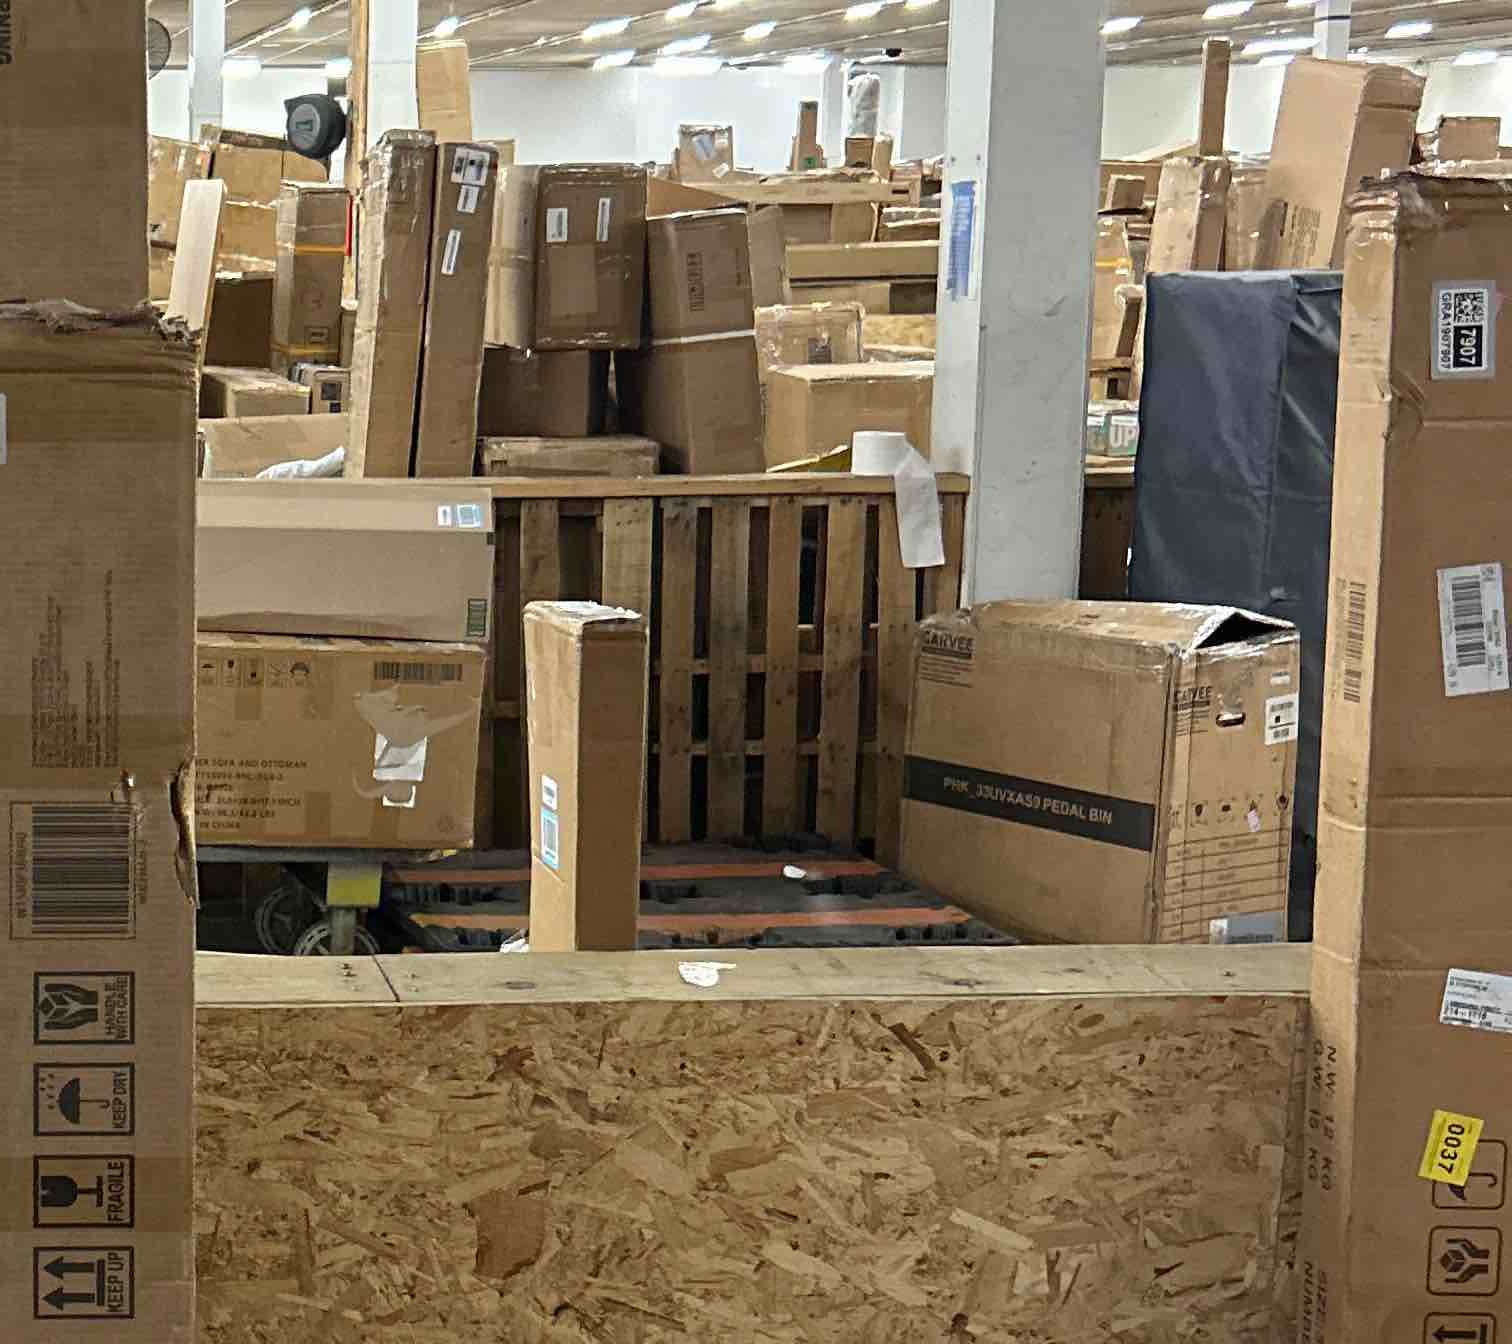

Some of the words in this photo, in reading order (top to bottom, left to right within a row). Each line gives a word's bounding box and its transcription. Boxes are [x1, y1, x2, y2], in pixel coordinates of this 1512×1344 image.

[1459, 327, 1477, 365] 7907
[1042, 798, 1087, 820] PEDAL
[1088, 808, 1113, 825] BIN
[116, 975, 128, 1007] CARE
[106, 983, 116, 1036] HANDLE
[112, 1070, 127, 1095] DRY
[112, 1097, 127, 1129] KEEP
[1438, 1123, 1465, 1174] 0037
[106, 1160, 125, 1223] FRAGILE
[106, 1250, 125, 1272] UP
[106, 1274, 125, 1313] KEEP
